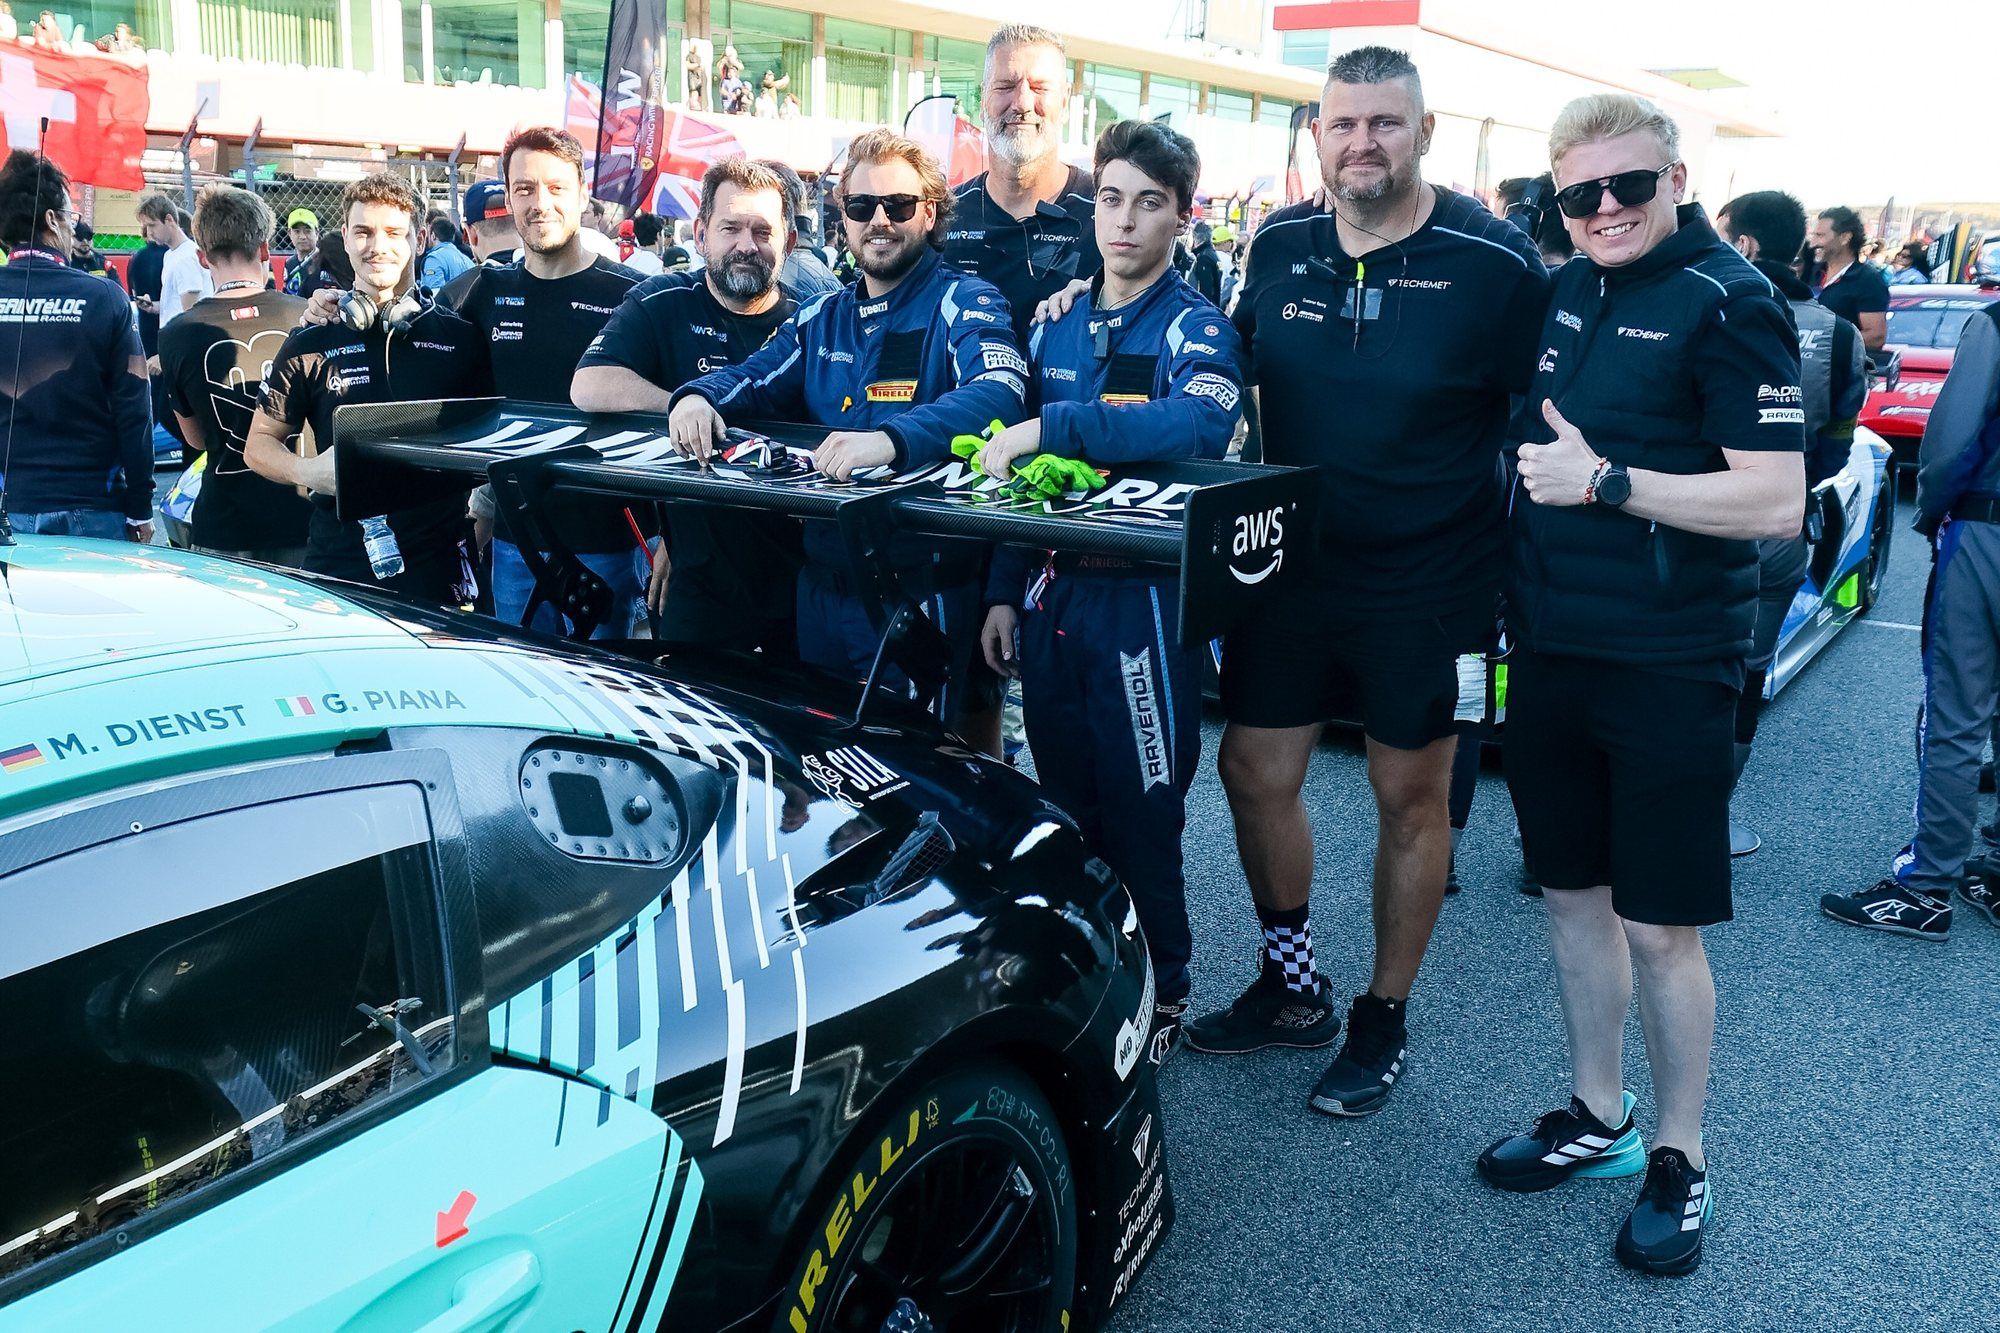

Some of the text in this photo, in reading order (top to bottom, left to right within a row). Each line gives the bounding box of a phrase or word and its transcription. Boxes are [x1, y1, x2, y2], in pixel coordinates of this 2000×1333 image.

[645, 123, 655, 157] RACING
[1399, 280, 1449, 290] TECHEMET
[578, 303, 614, 314] TECHEMET
[859, 301, 888, 318] freem
[963, 309, 996, 323] freem
[40, 315, 81, 323] RACING
[1625, 328, 1668, 341] TECHEMET
[420, 342, 455, 352] TECHEMET
[1183, 341, 1218, 355] freem
[987, 353, 1025, 368] MANN
[872, 386, 914, 398] PIRELLI
[1233, 506, 1283, 556] aws
[322, 690, 467, 713] G. PIANA
[1131, 663, 1162, 777] RAVENOL
[47, 704, 247, 760] M. DIENST
[825, 745, 901, 791] SILA
[1118, 1140, 1161, 1225] TECHEMET
